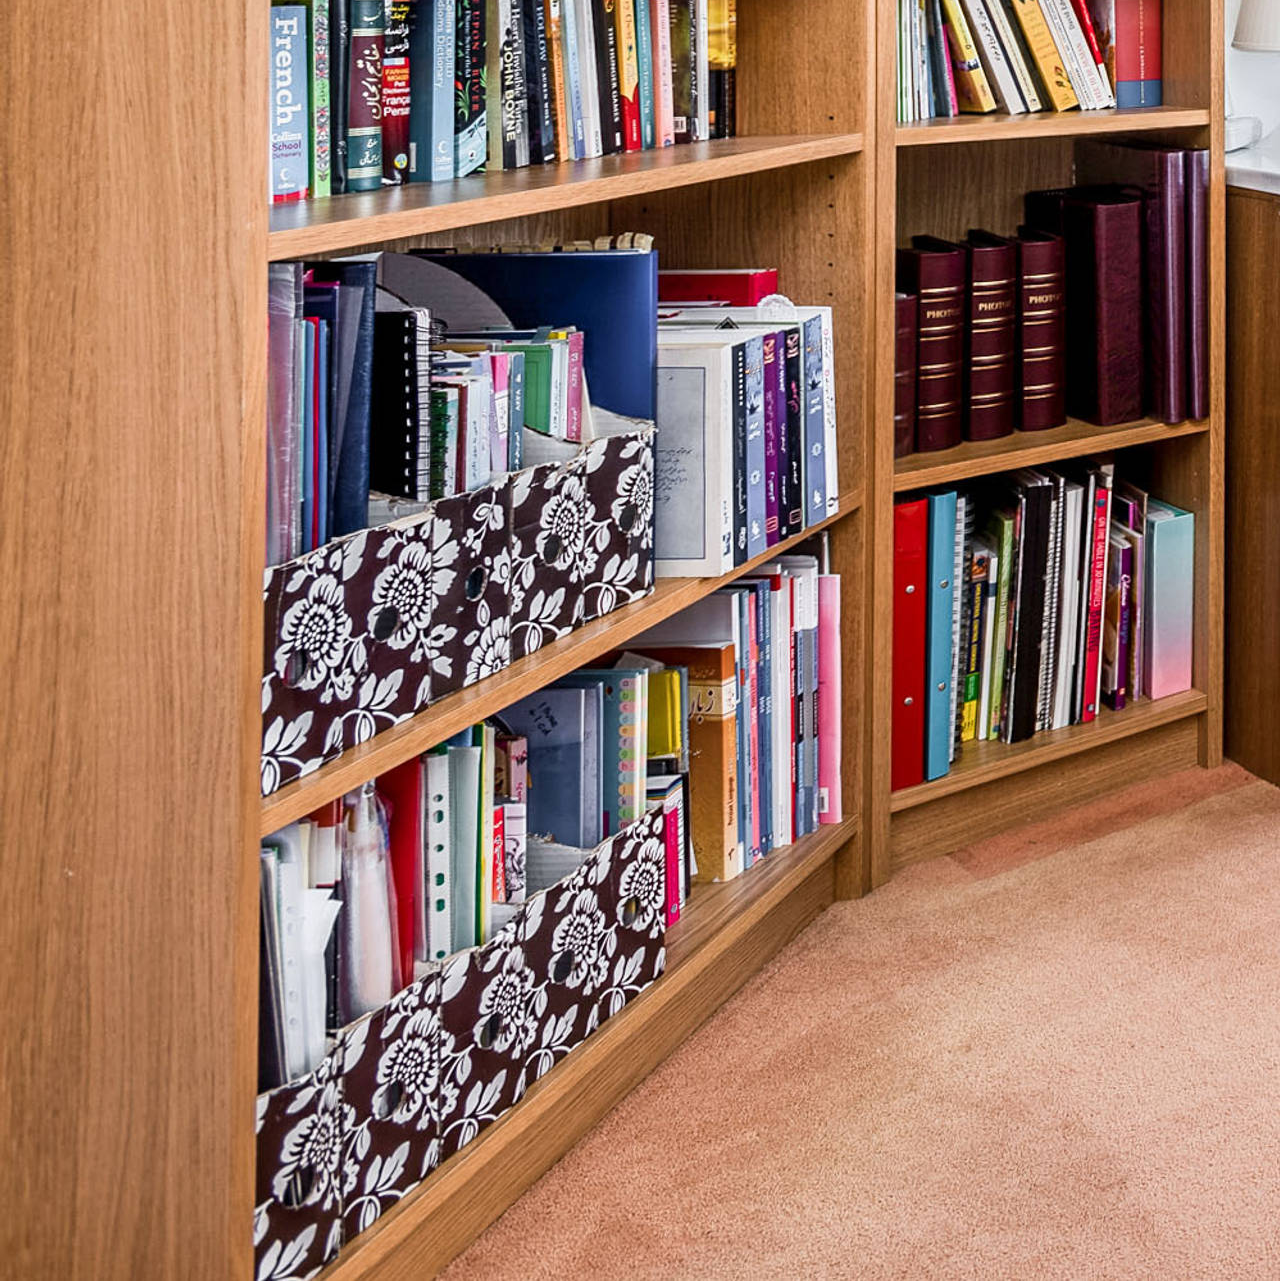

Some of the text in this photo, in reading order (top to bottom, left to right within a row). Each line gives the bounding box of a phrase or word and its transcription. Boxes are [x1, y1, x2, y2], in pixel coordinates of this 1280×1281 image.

[471, 11, 480, 51] UPON
[536, 6, 546, 61] HOLLOW
[275, 17, 301, 126] French
[434, 36, 445, 87] Dictionary
[445, 36, 453, 78] COBUILD
[512, 51, 523, 96] Invisible
[609, 48, 617, 88] HUNGER
[472, 69, 480, 112] RIVER
[503, 44, 516, 142] JOHN BOYNE
[272, 140, 302, 151] School
[1096, 541, 1104, 560] TABLE
